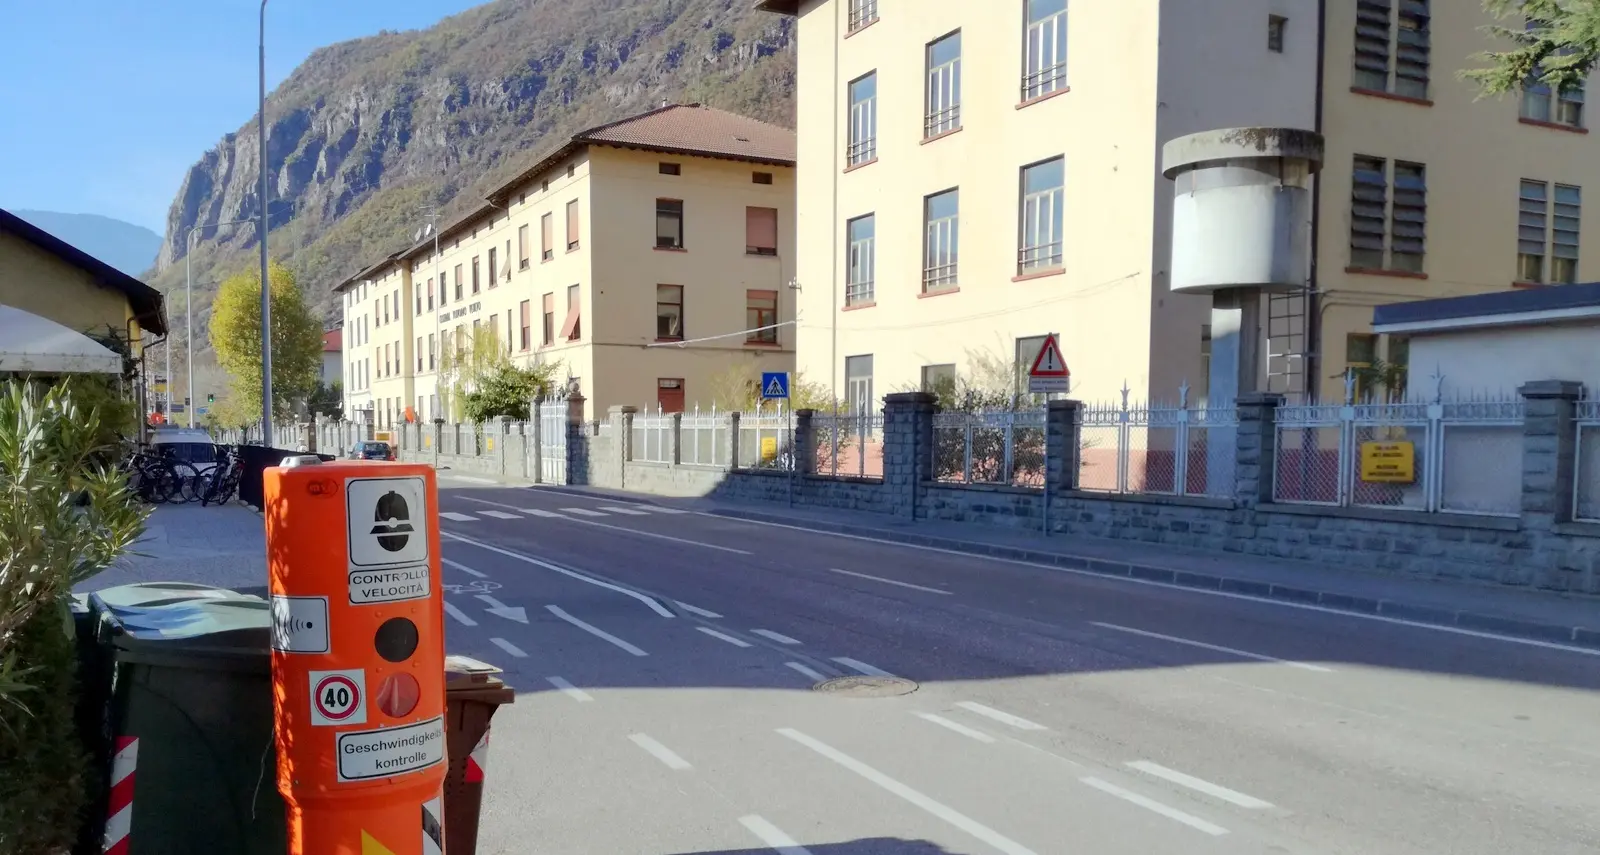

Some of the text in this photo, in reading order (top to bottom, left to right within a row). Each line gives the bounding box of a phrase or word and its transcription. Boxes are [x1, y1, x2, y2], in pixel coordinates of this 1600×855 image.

[353, 570, 427, 584] CONTROLLO
[325, 688, 349, 707] 40
[375, 752, 427, 769] kontrolle
